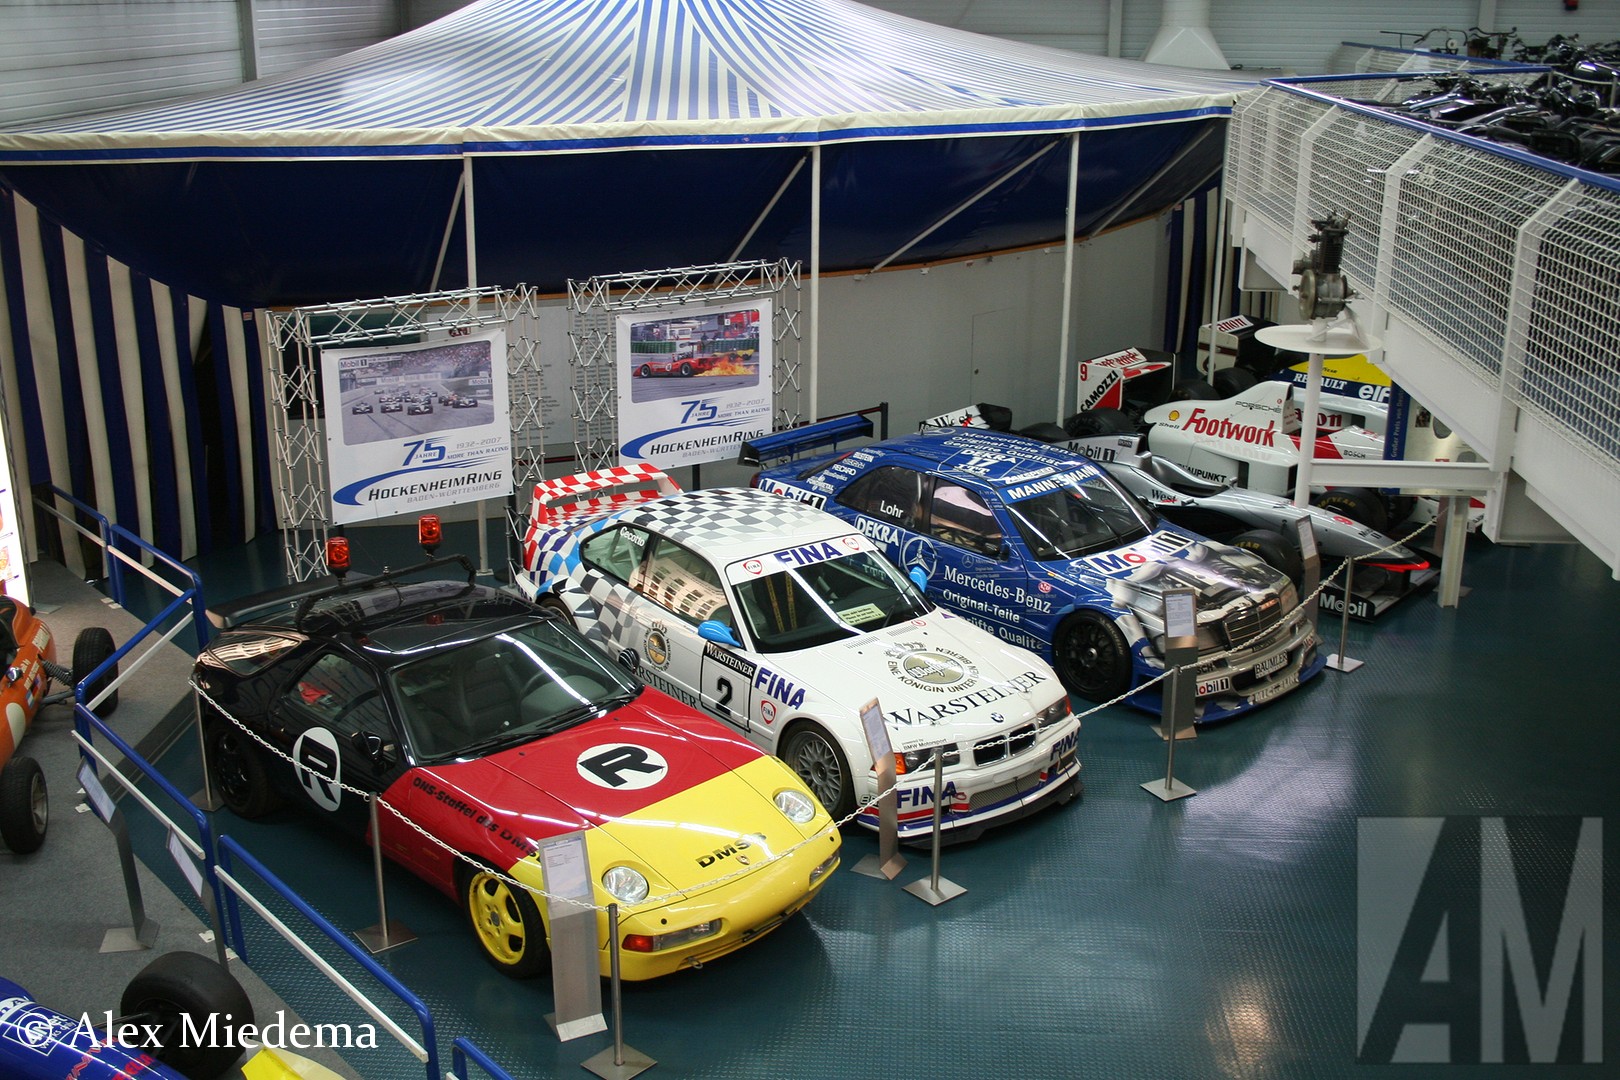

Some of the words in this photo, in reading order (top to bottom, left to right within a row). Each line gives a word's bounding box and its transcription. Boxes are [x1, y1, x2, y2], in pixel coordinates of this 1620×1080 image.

[1216, 317, 1248, 332] anon
[1080, 364, 1088, 382] 9
[1292, 373, 1348, 390] REAULT
[1080, 370, 1119, 412] CAMOZZI
[1358, 384, 1391, 402] elf
[680, 397, 719, 424] 75
[1235, 400, 1282, 414] PORSCHE
[1182, 408, 1276, 448] Footwork
[402, 437, 447, 466] 75
[456, 436, 502, 449] 1932-2007
[486, 446, 509, 454] RACING
[943, 440, 1002, 454] Geprüfte
[1007, 450, 1061, 466] Qualität
[952, 436, 1039, 454] Original-Teile
[959, 432, 1079, 458] Mercedes-Benz
[1068, 441, 1102, 460] Mobil
[1103, 448, 1115, 462] 1
[960, 450, 1017, 464] DEKRA
[970, 456, 1000, 468] 17
[1344, 450, 1366, 458] BOSCH
[832, 464, 857, 476] RECARO
[1178, 464, 1227, 483] AUPUNKT
[407, 482, 500, 503] BADEN-WÜRTTEMBERG
[1008, 465, 1101, 500] MANNESMANN
[1151, 488, 1176, 503] West
[880, 500, 904, 518] Lohr
[620, 526, 645, 546] Cecotto
[856, 518, 899, 546] DEKRA
[773, 542, 843, 565] FINA
[944, 565, 1052, 614] Mercedes-Benz
[943, 589, 1020, 624] Original-Teile
[998, 627, 1044, 650] Qualitä
[705, 641, 754, 676] WARSTEINER
[888, 660, 902, 676] EINE
[898, 676, 944, 693] KÖNIGIN
[947, 678, 978, 693] UNTER
[634, 667, 699, 710] ARSTEINER
[716, 678, 733, 716] 2
[755, 667, 806, 710] FINA
[1196, 681, 1219, 696] obil
[883, 671, 1048, 730] WARSTEINER
[918, 738, 947, 748] Motorsport
[300, 735, 338, 805] R
[578, 746, 665, 788] R
[897, 781, 957, 808] FINA
[476, 814, 500, 832] des
